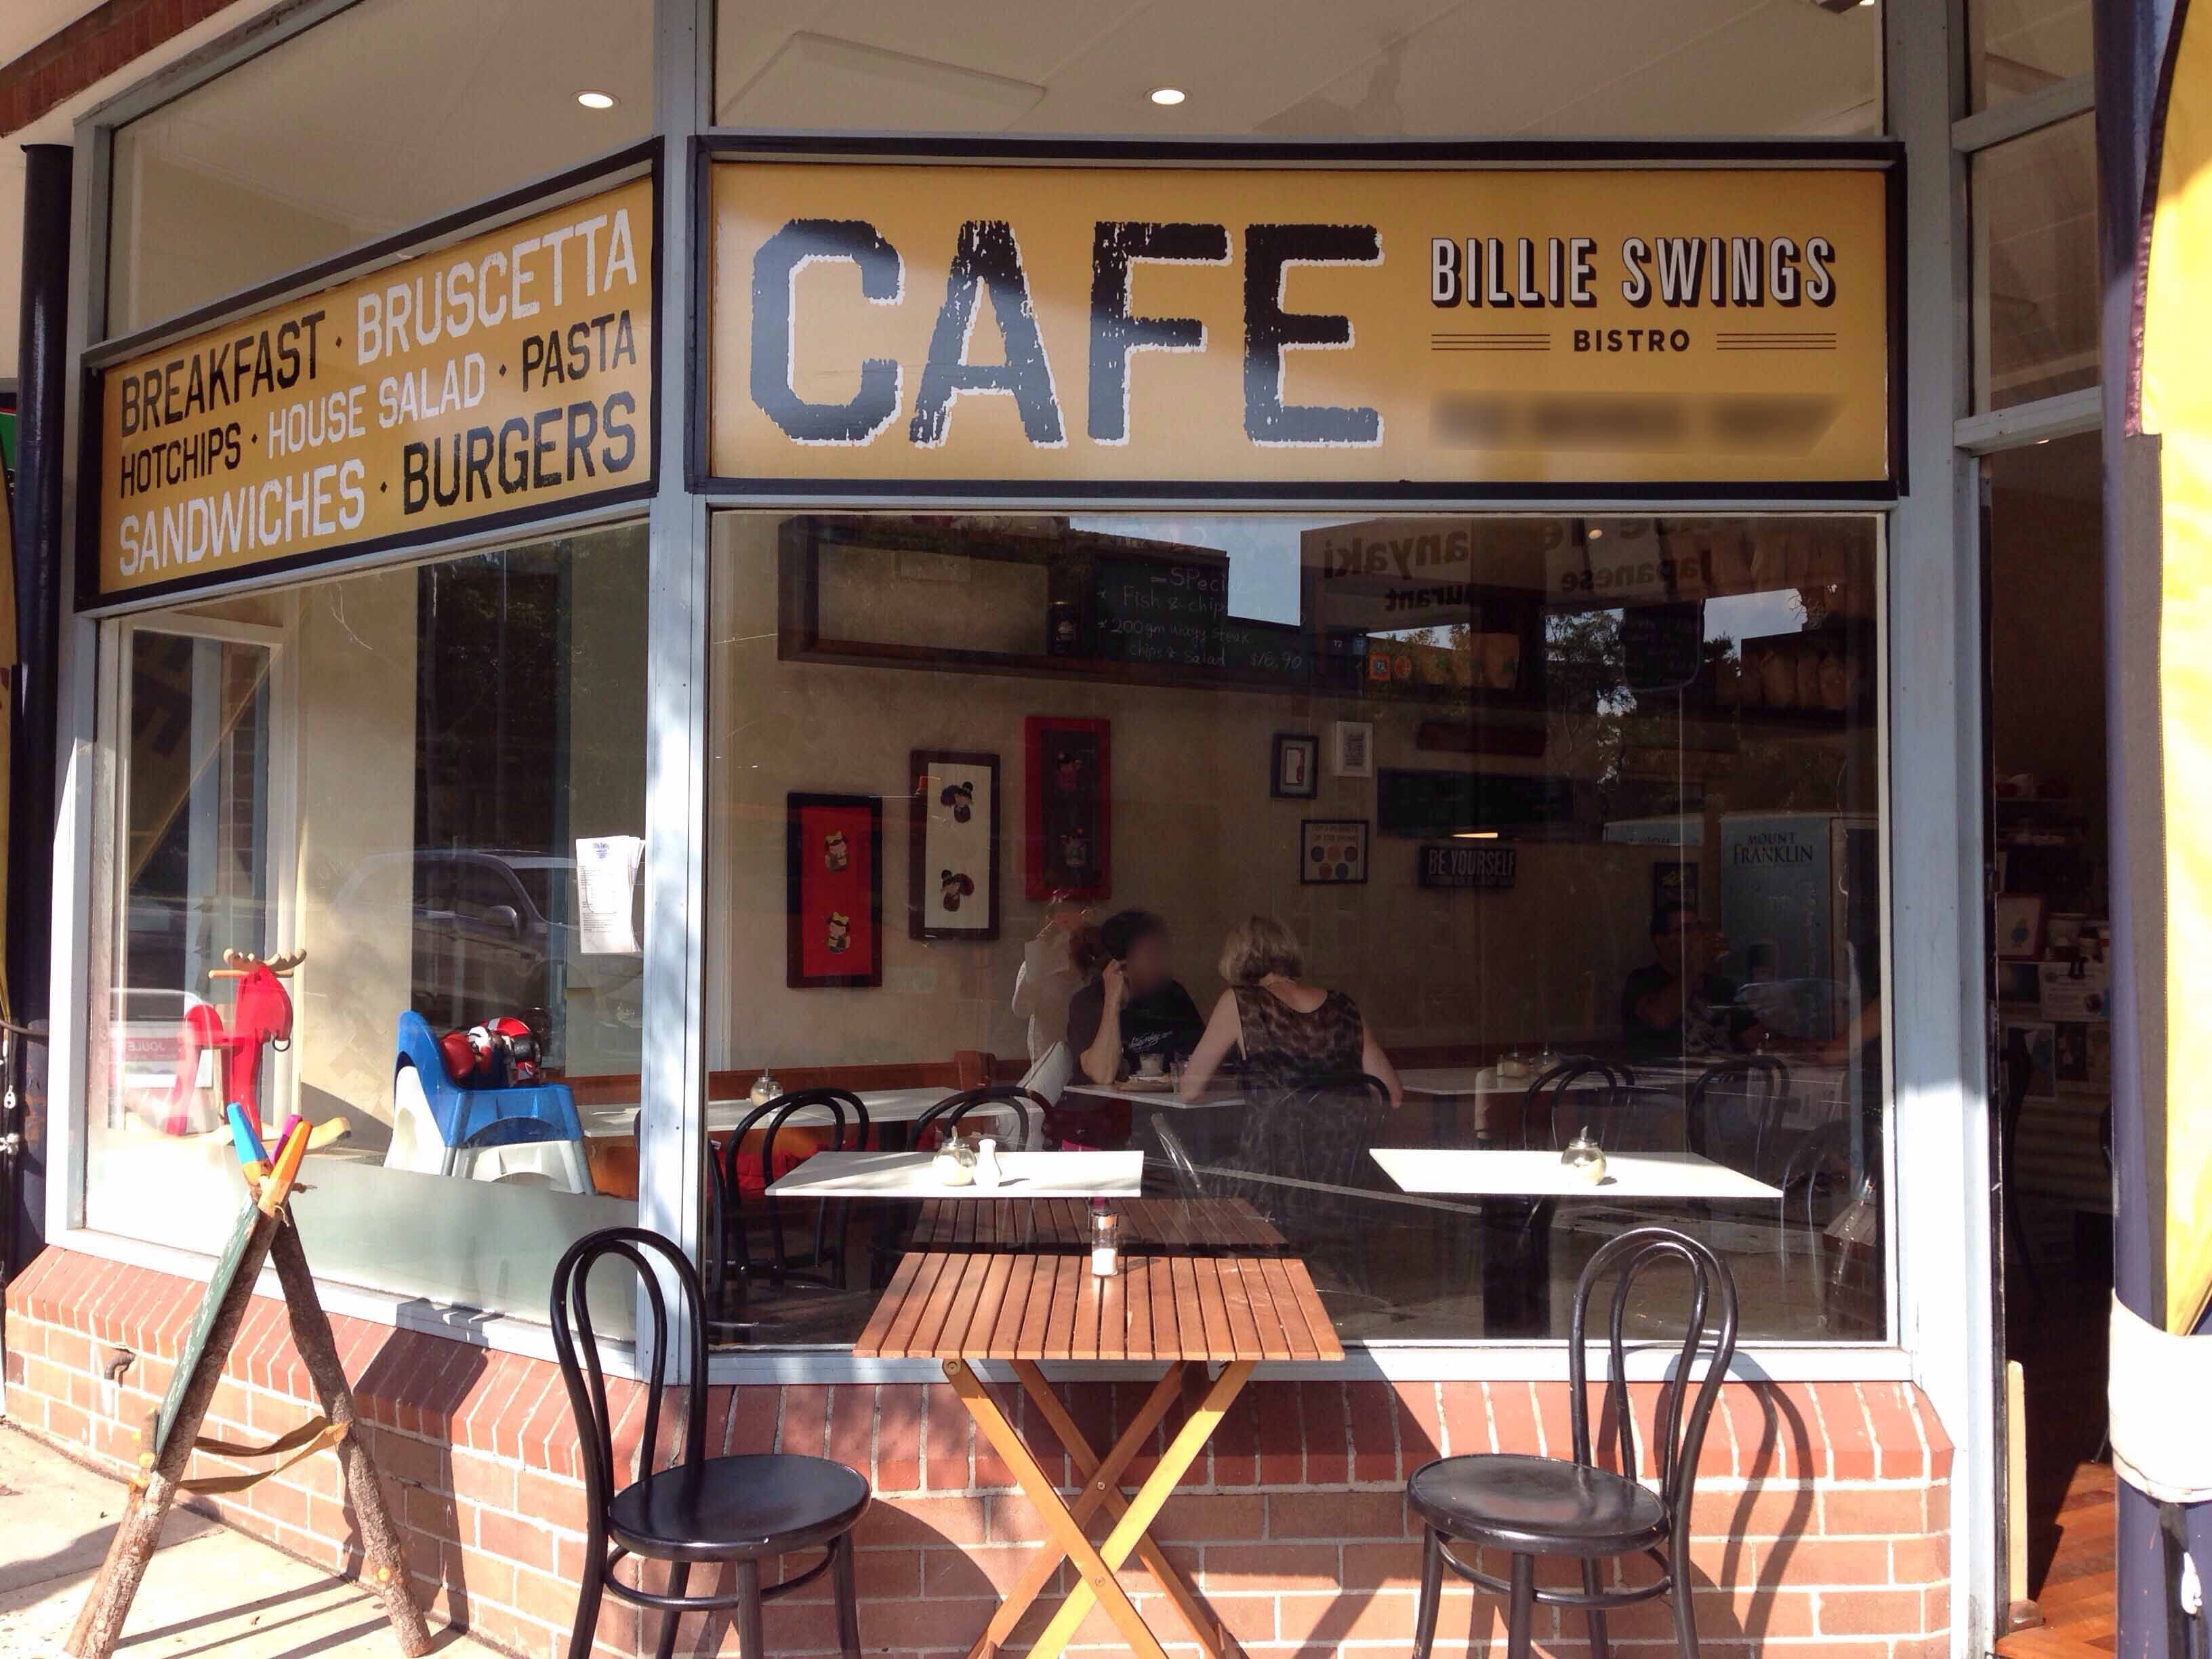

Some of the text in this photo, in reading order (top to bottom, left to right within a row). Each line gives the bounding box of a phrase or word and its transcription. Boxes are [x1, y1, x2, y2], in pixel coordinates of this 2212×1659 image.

[1431, 237, 1837, 308] BILLIE SWINGS
[121, 207, 638, 438] BREAKFAST BRUSCETTA
[750, 218, 1385, 449] CAFE
[1573, 329, 1691, 353] BISTRO
[120, 309, 638, 500] HOTCHIPS HOUSE SALAD PASTA
[119, 390, 637, 577] SANDWICHES BURGERS
[1187, 594, 1228, 619] chip
[1429, 849, 1514, 876] BE YOURSELF
[1734, 844, 1814, 865] FRANKLIN
[1746, 832, 1796, 845] MOUNT
